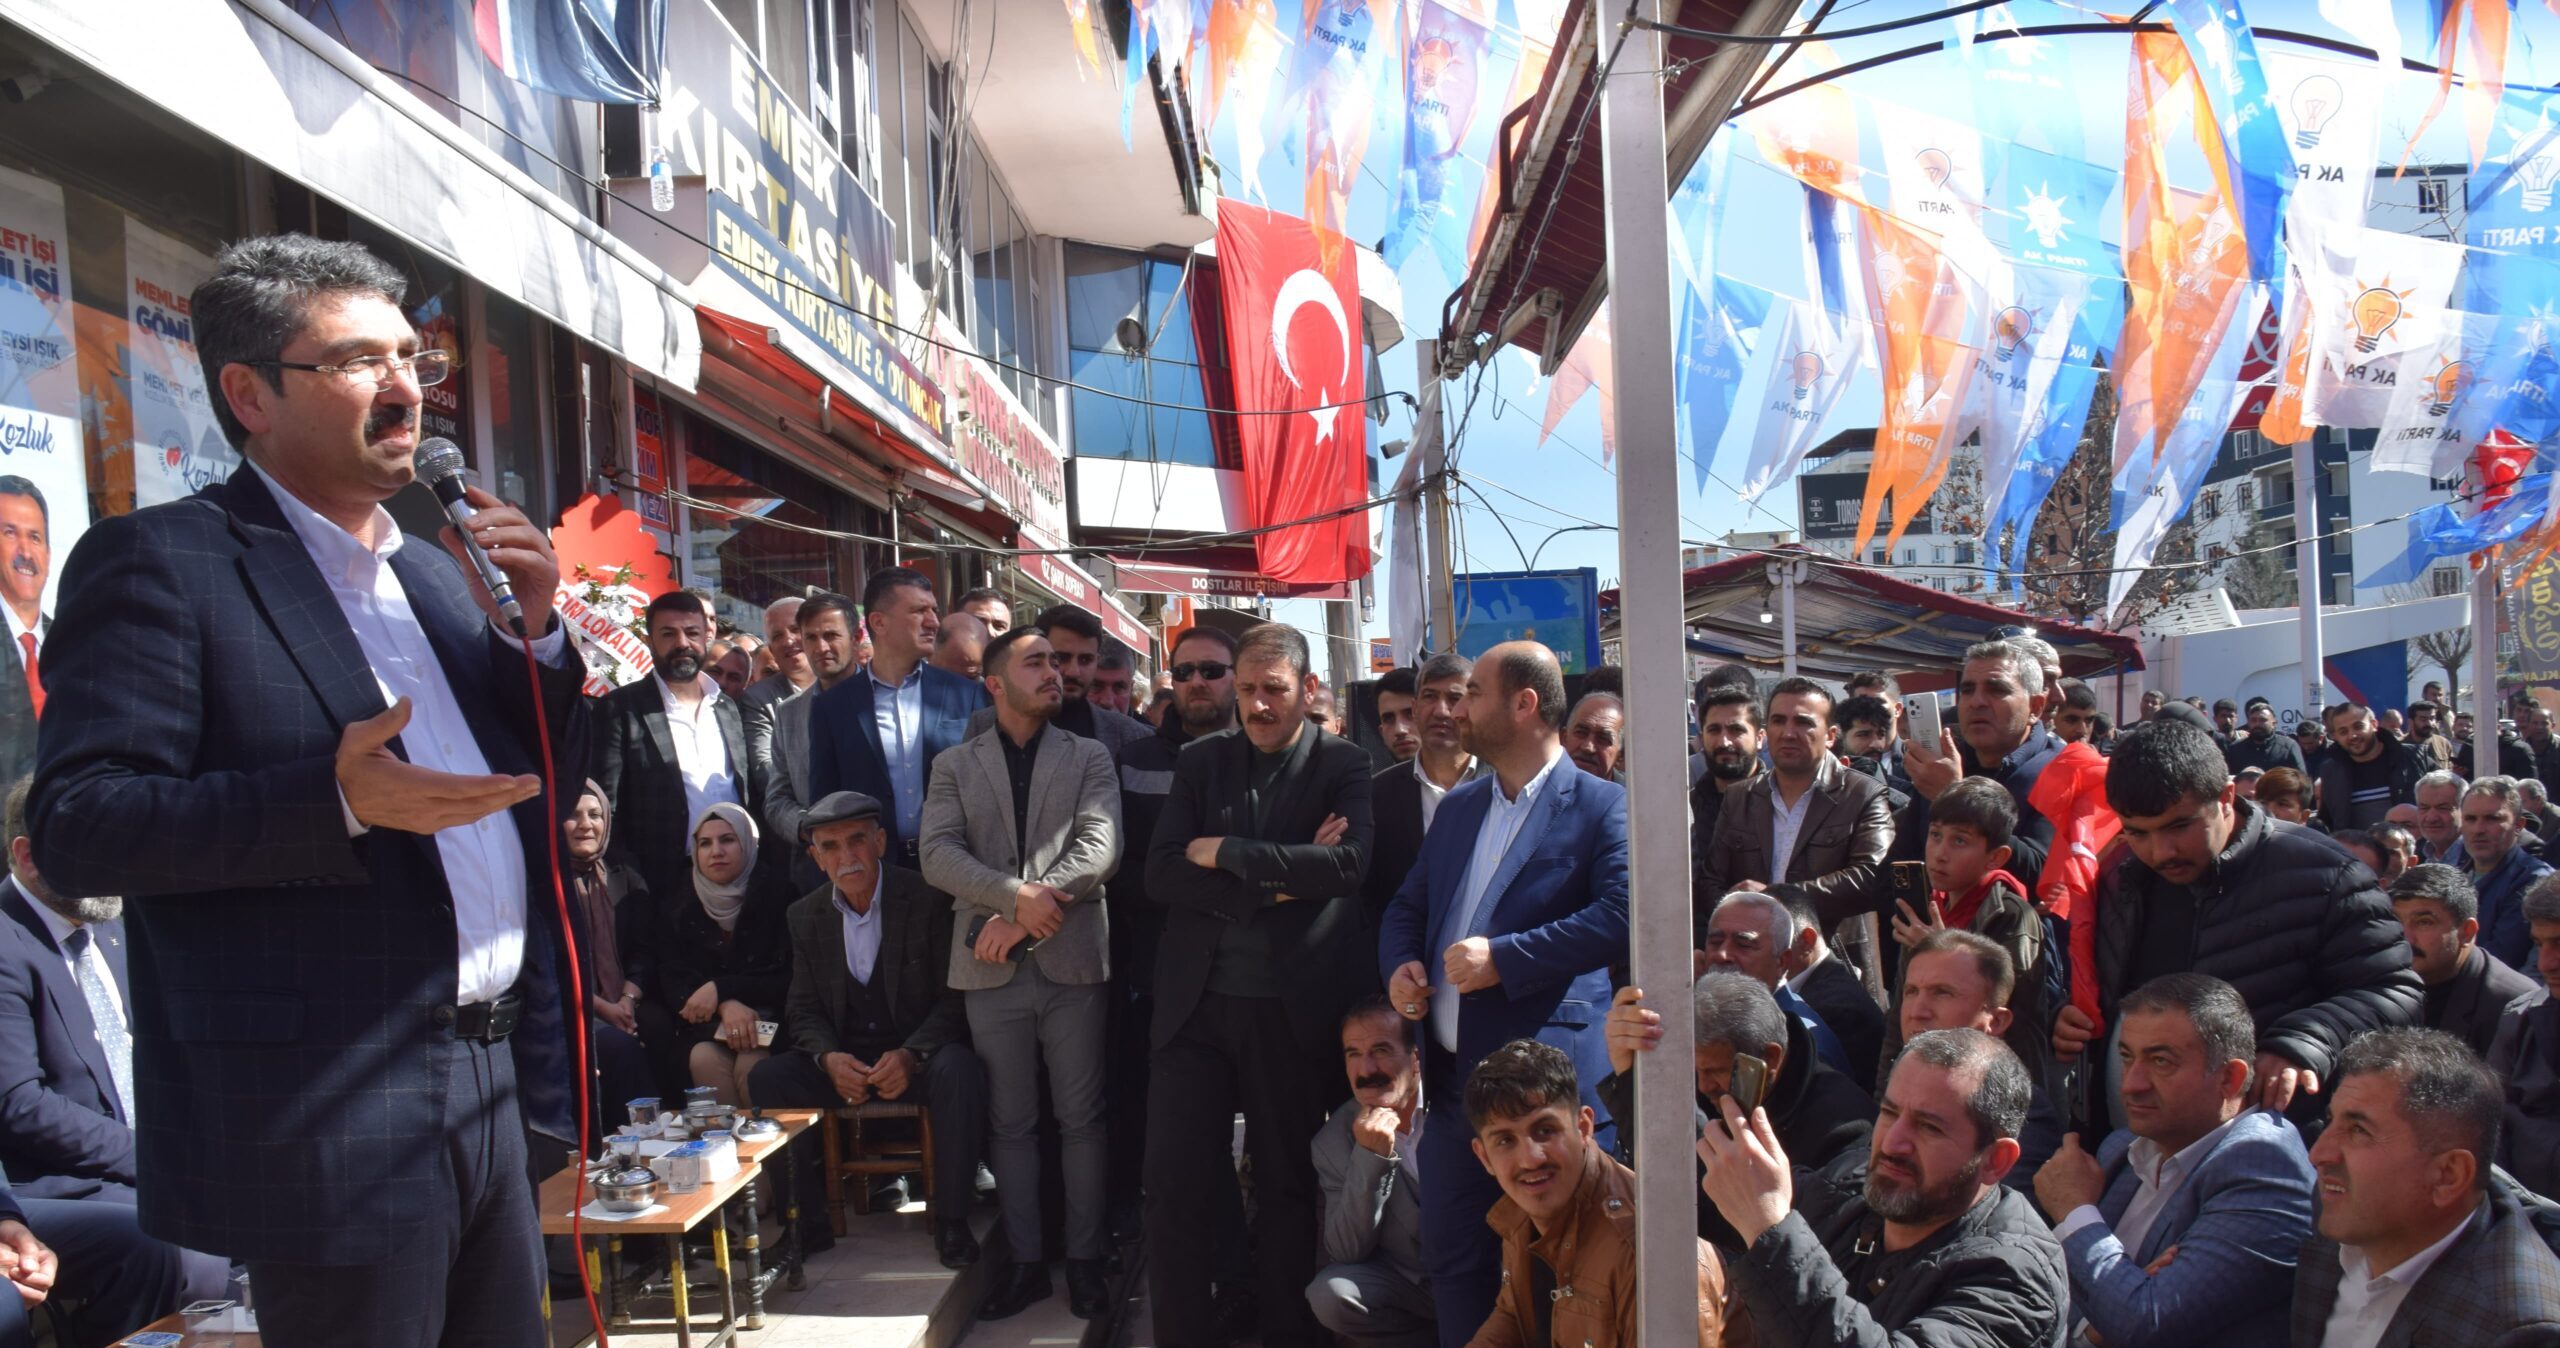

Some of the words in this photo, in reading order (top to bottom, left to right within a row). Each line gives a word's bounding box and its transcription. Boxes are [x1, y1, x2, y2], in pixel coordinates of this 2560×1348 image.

[730, 44, 838, 218] EMEK
[657, 67, 895, 339] KIRTASİYE
[31, 232, 57, 266] İŞİ
[24, 258, 60, 305] İŞİ
[716, 208, 780, 302] EMEK
[784, 266, 872, 374] KIRTASİYE
[873, 343, 885, 384] &
[887, 364, 944, 438] OYUNCAK
[34, 338, 61, 361] IŞIK
[1771, 401, 1790, 413] AK
[2143, 485, 2165, 498] AK
[1835, 499, 1862, 526] TOROS
[1191, 577, 1243, 592] DOSTLAR
[1244, 577, 1290, 597] İLETİŞİM
